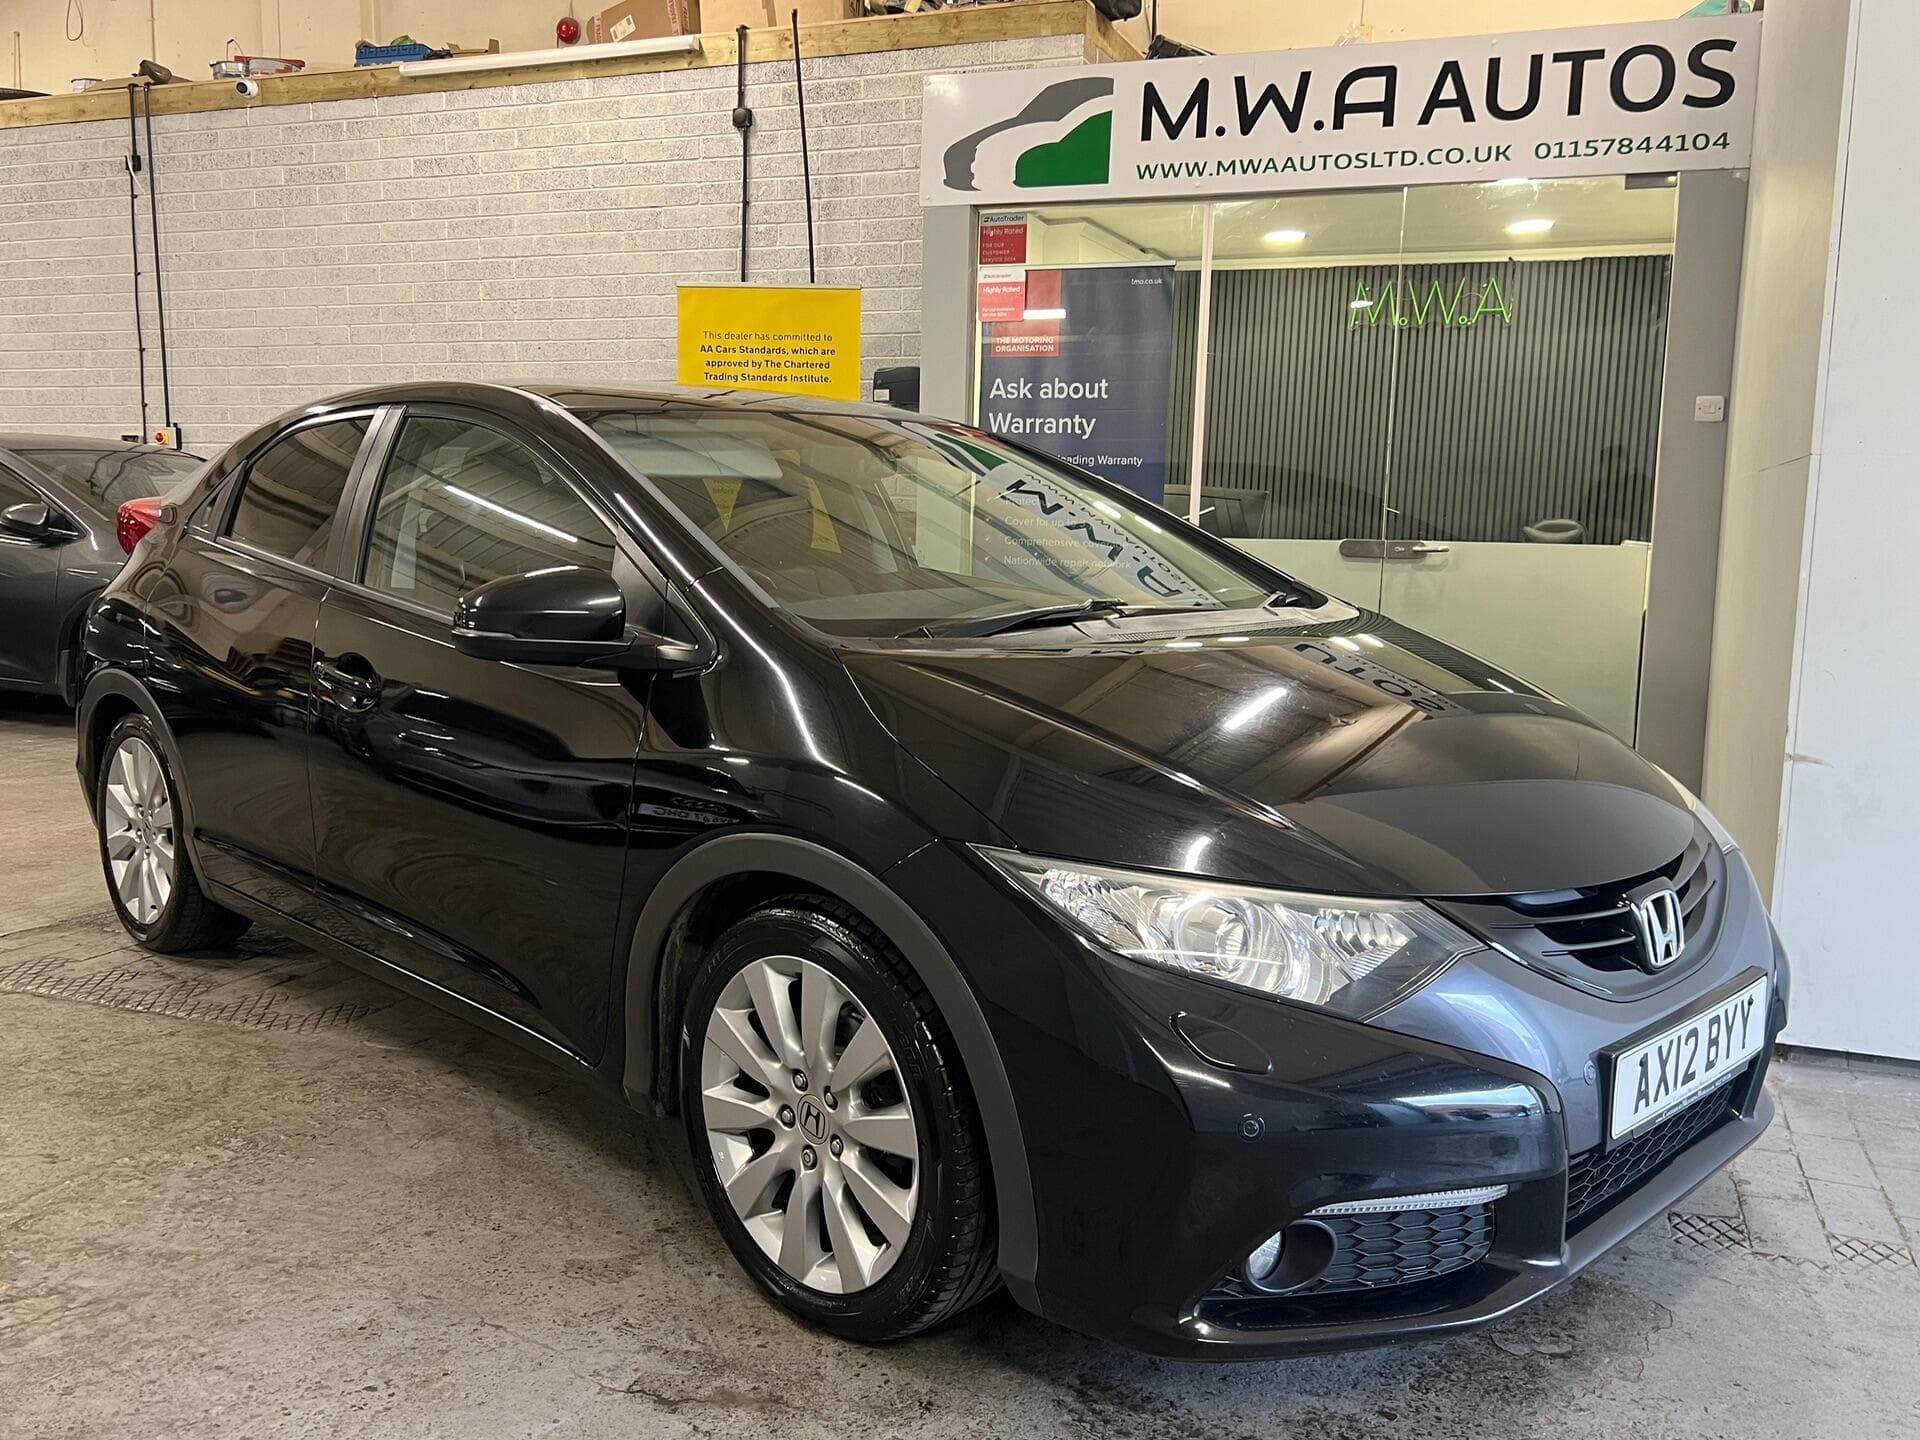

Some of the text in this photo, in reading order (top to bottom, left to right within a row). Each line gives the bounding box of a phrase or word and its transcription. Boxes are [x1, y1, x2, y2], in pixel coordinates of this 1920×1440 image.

[1141, 39, 1737, 142] M.W.A AUTOS
[1136, 132, 1730, 180] WWW.MWAAUTOSLTD.CO.UK 01157844104
[1004, 227, 1024, 235] Rated
[983, 286, 1002, 295] Highly
[1349, 277, 1511, 328] M.W.A
[703, 331, 833, 342] This dealer has committed to
[996, 335, 1055, 344] THE MOTORING
[700, 345, 713, 353] AA
[715, 345, 737, 354] Cars
[739, 346, 789, 355] Standards,
[791, 347, 819, 355] which
[995, 344, 1055, 353] ORGANISATION
[705, 360, 830, 369] approved by The Chartered
[704, 372, 832, 383] Trading Standards Institute.
[989, 377, 1109, 399] Ask about
[988, 412, 1097, 440] Warranty
[1097, 455, 1143, 467] Warranty
[1004, 515, 1035, 526] Cover
[1036, 516, 1050, 526] for
[1051, 518, 1064, 528] up
[1004, 536, 1080, 547] Comprehensive
[1003, 556, 1058, 567] Nationwide
[1060, 558, 1090, 569] repair
[1633, 1026, 1700, 1115] AX12
[1704, 994, 1754, 1073] BYY
